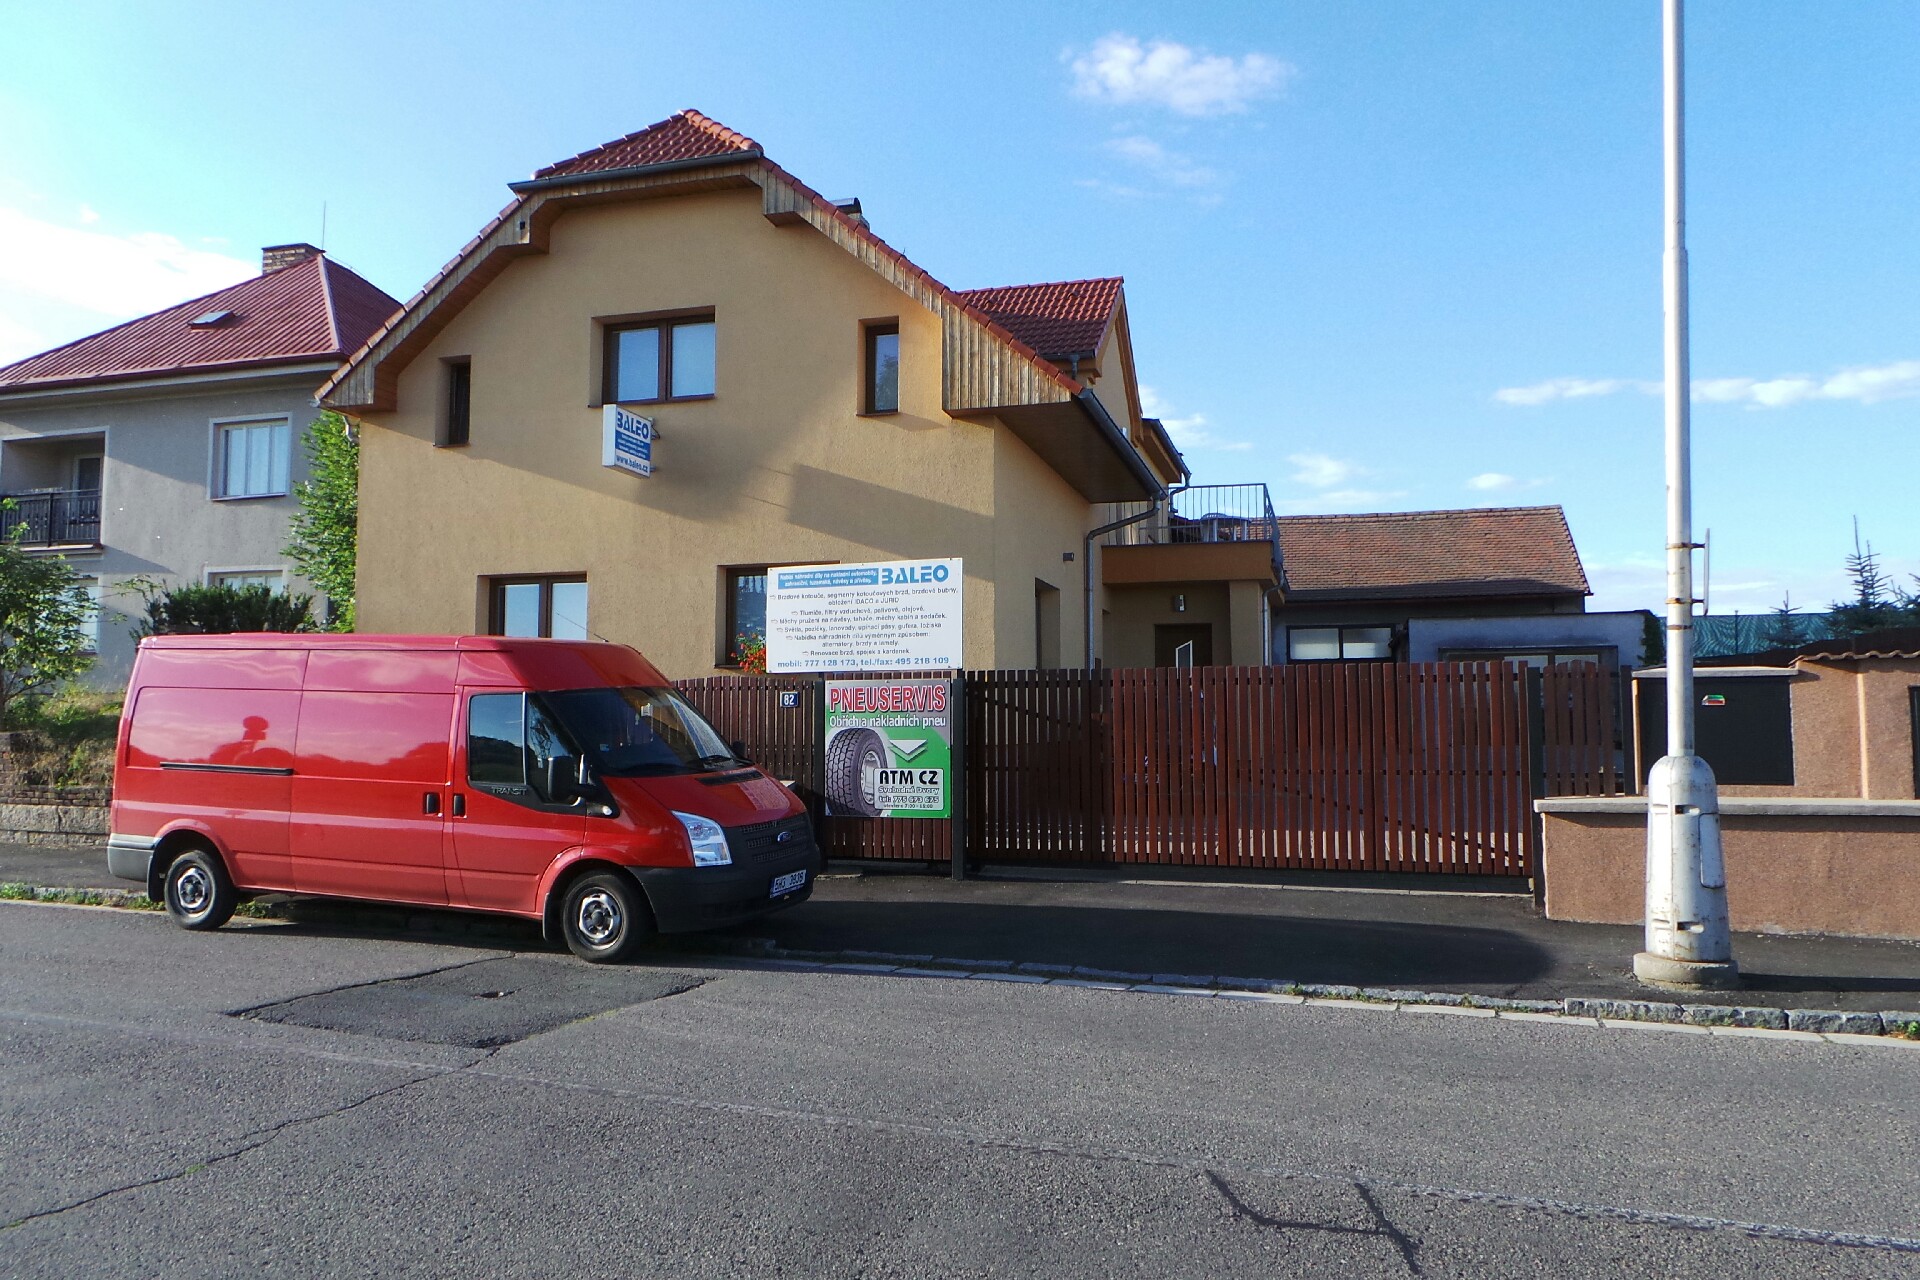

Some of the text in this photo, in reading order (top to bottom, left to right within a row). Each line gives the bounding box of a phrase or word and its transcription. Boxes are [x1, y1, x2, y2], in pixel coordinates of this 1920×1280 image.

[617, 412, 648, 439] BALEO
[617, 456, 648, 472] www.baleo.cz
[882, 564, 949, 584] BALEO
[876, 614, 896, 622] měchy
[856, 640, 872, 648] brzdy
[778, 660, 802, 668] mobil:
[841, 659, 858, 667] 173,
[861, 658, 893, 667] tel./fax:
[784, 695, 795, 705] 82
[830, 685, 946, 713] PNEUSERVIS
[830, 714, 945, 729] Obřích a nákladních pneu
[880, 770, 938, 784] ATM CZ
[492, 786, 527, 795] TRANSIT
